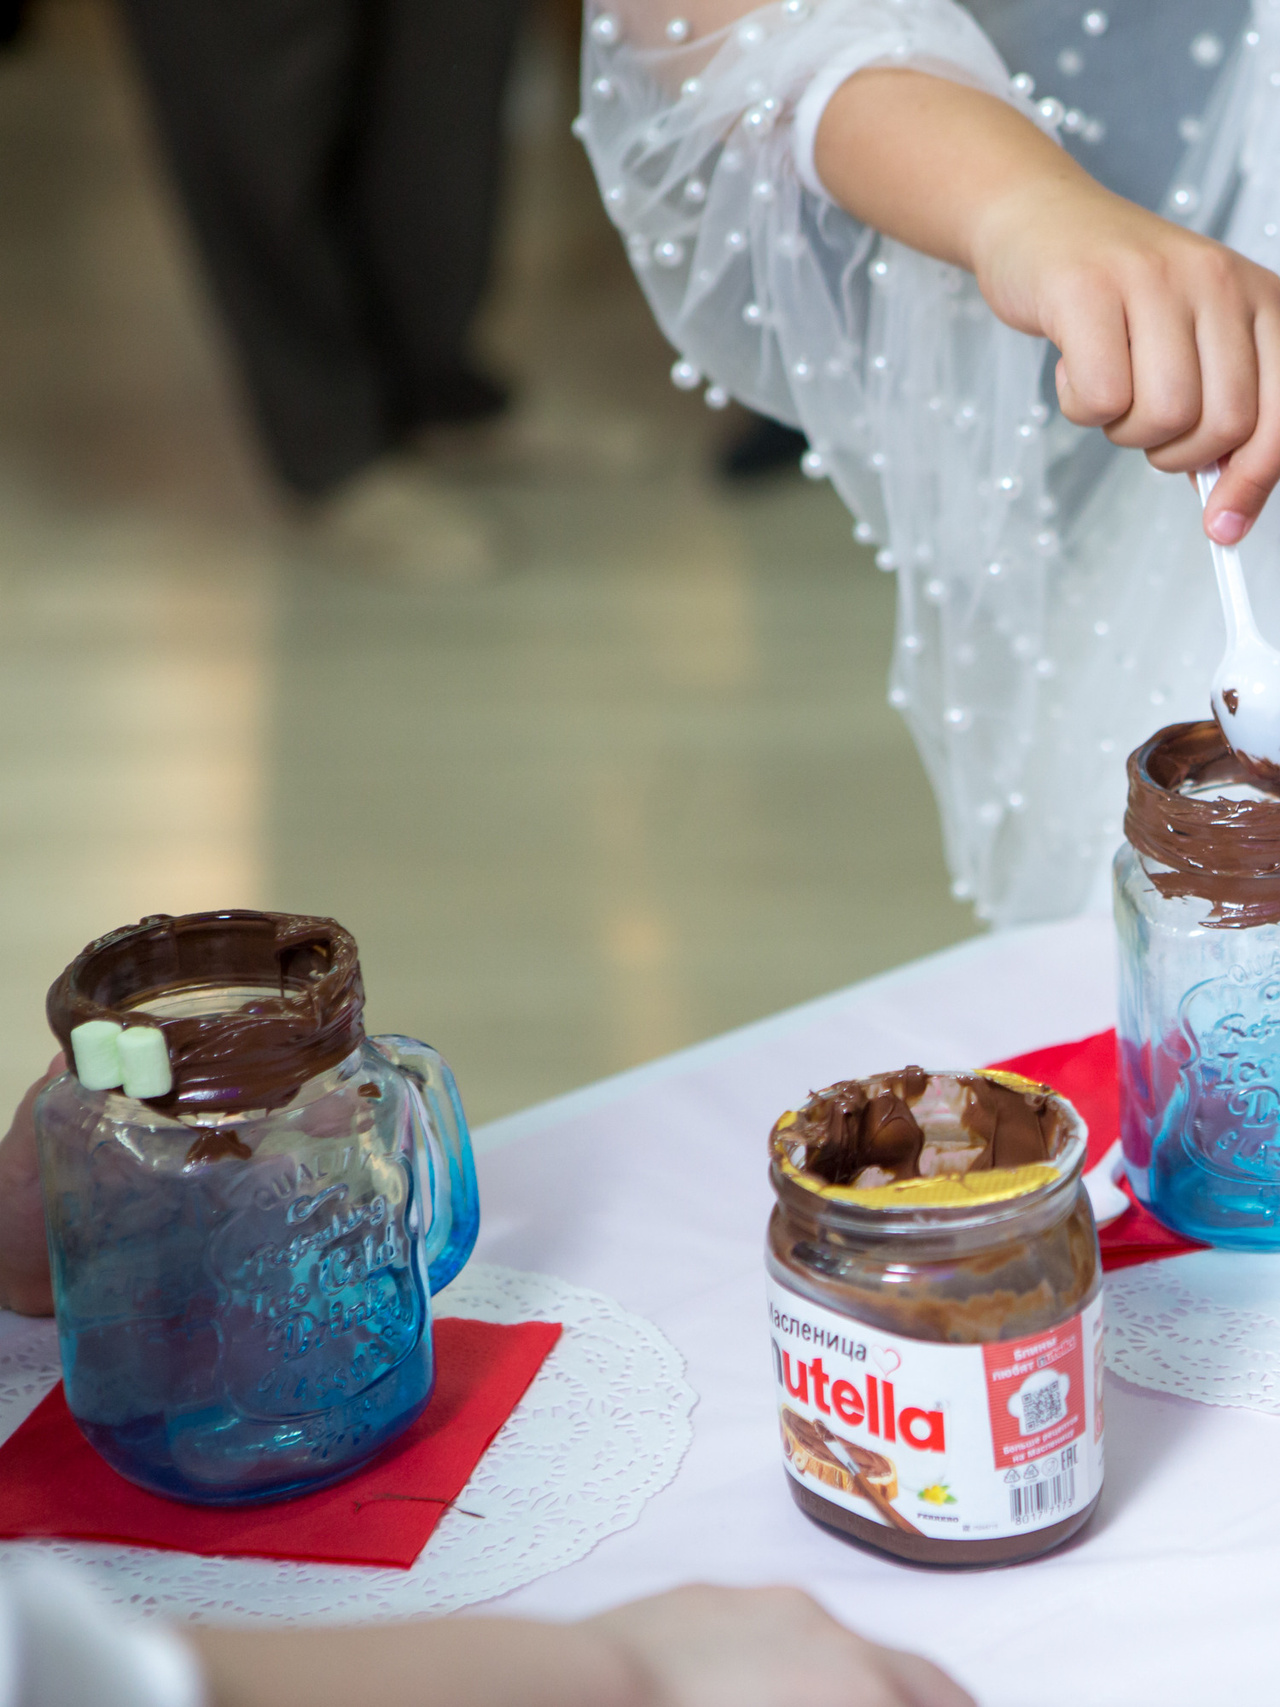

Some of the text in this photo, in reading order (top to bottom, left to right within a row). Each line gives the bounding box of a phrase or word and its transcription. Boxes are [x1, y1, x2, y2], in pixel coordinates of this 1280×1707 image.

[319, 1220, 397, 1295] Cold
[992, 1336, 1077, 1382] любят nutella
[1013, 1337, 1058, 1362] Блины
[1002, 1437, 1041, 1456] Больше
[1012, 1452, 1025, 1464] на
[916, 1512, 960, 1524] FERRERO
